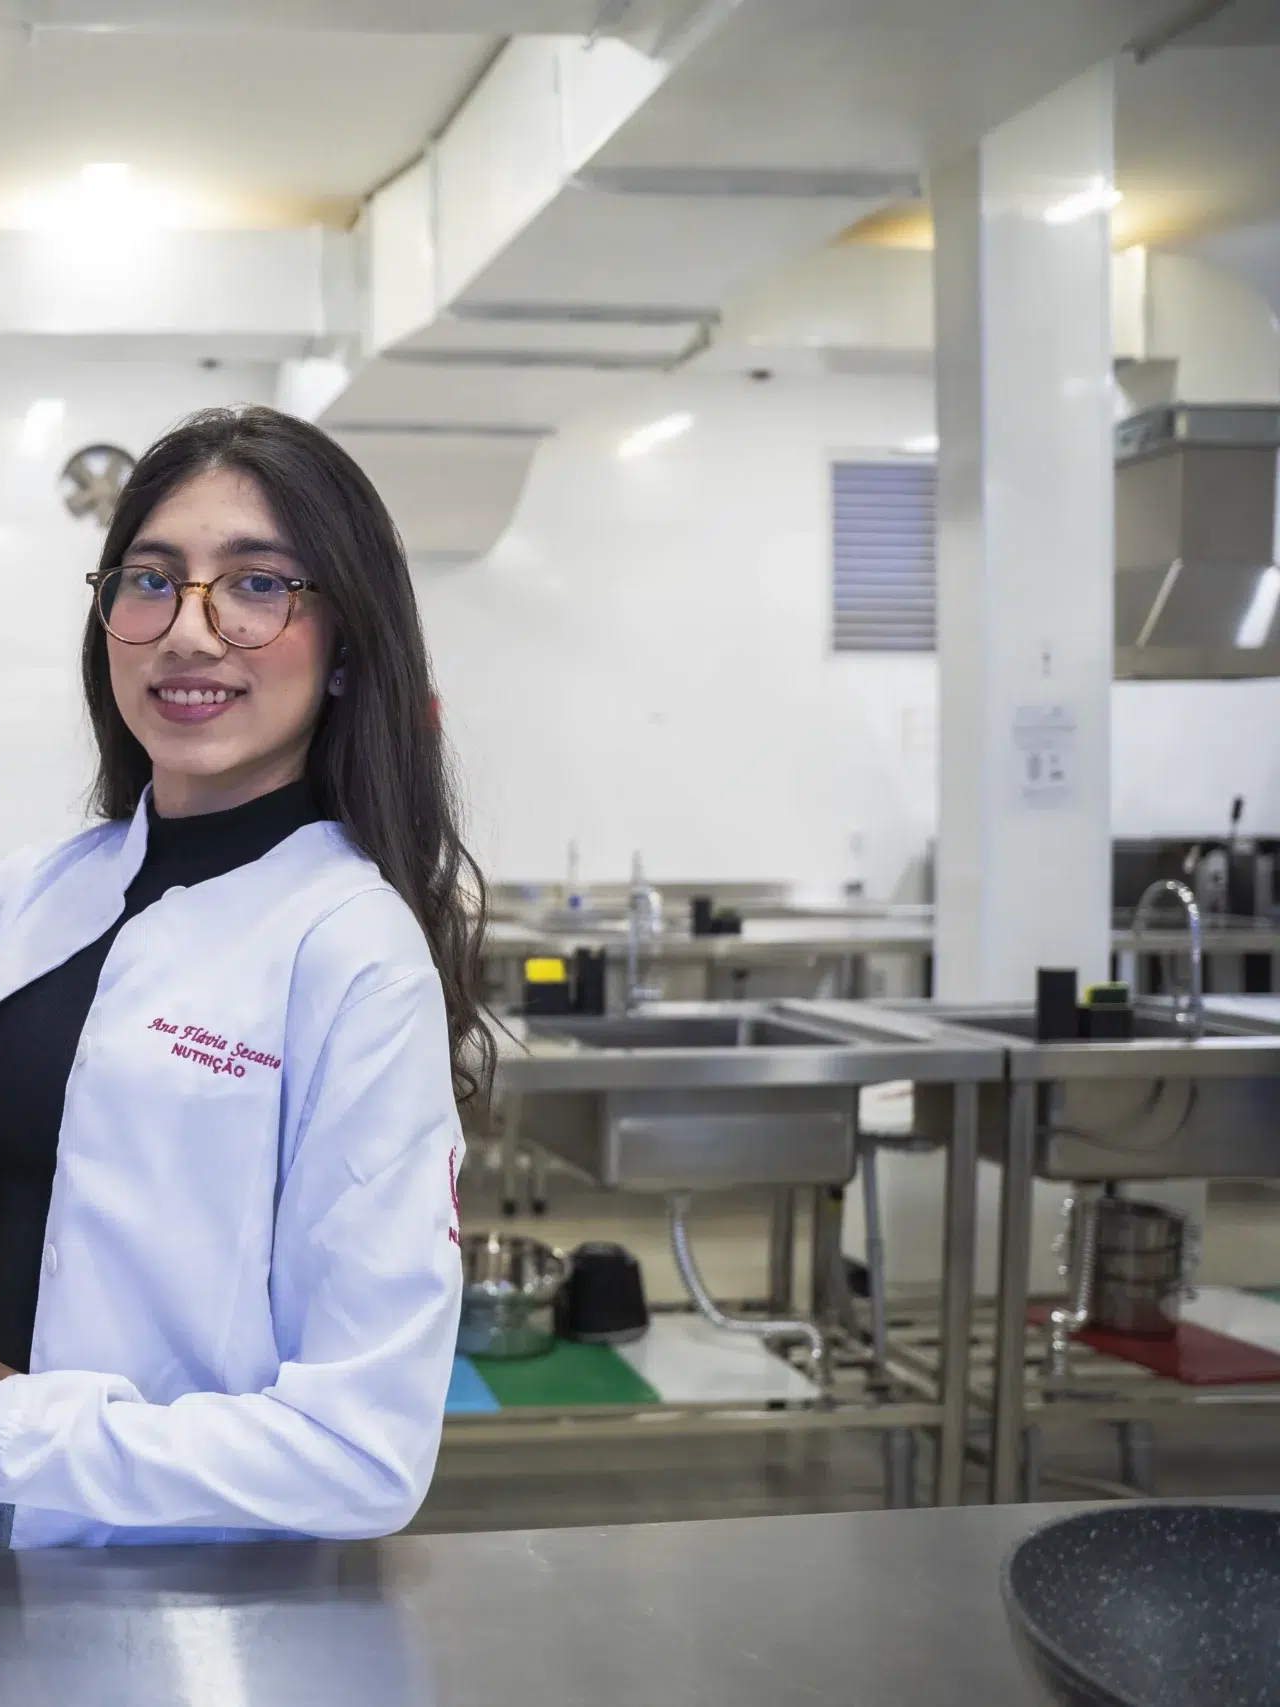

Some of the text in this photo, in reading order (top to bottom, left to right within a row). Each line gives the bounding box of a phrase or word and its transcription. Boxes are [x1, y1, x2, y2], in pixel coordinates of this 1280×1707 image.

[148, 1017, 179, 1035] Ana
[179, 1025, 228, 1051] Flávia
[171, 1042, 246, 1078] NUTRIÇÃO
